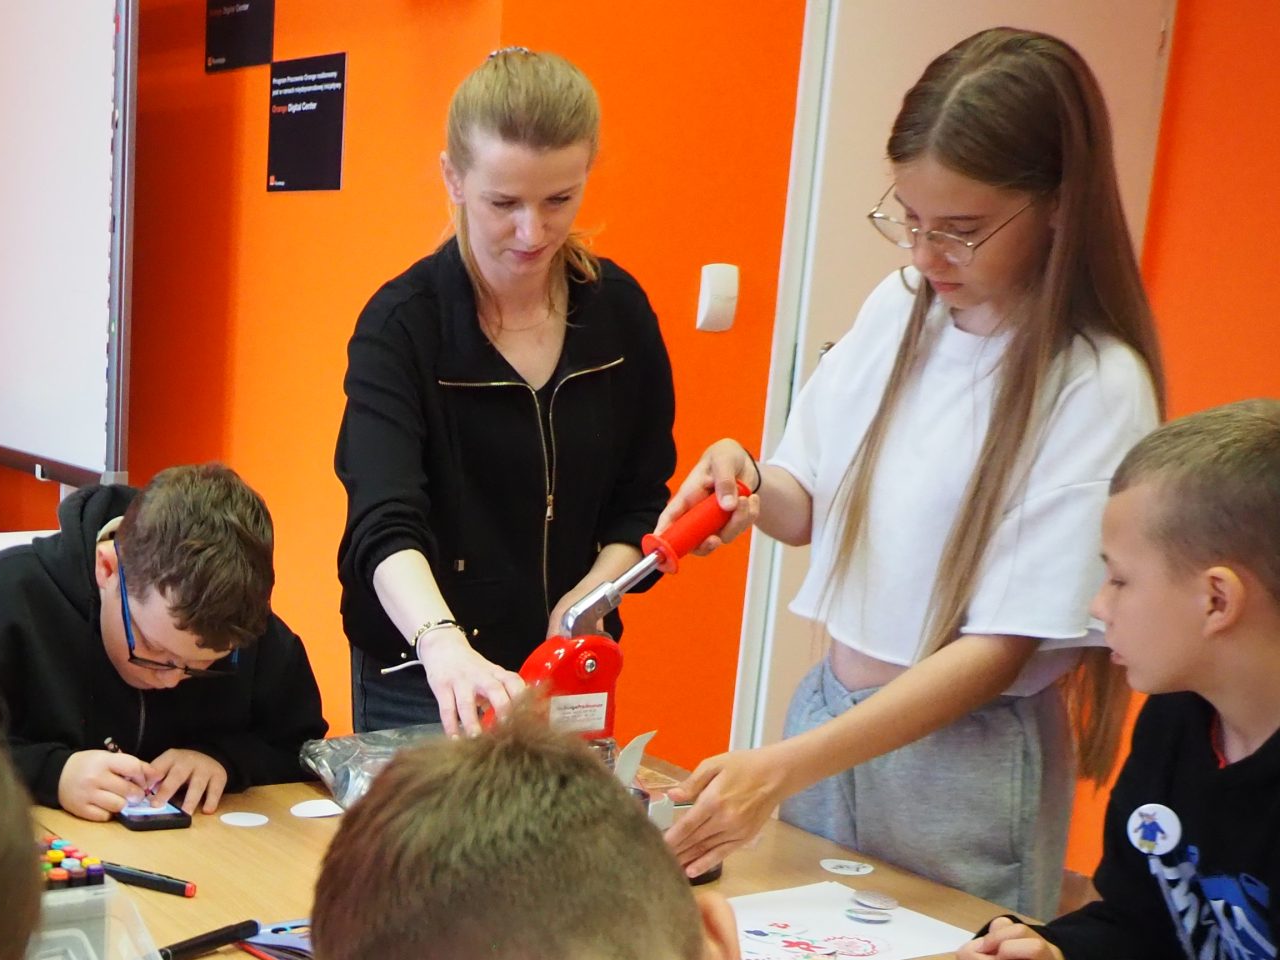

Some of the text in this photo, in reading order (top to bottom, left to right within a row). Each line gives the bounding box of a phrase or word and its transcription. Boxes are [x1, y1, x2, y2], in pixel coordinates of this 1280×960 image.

[272, 101, 318, 115] Orange Digital Center
